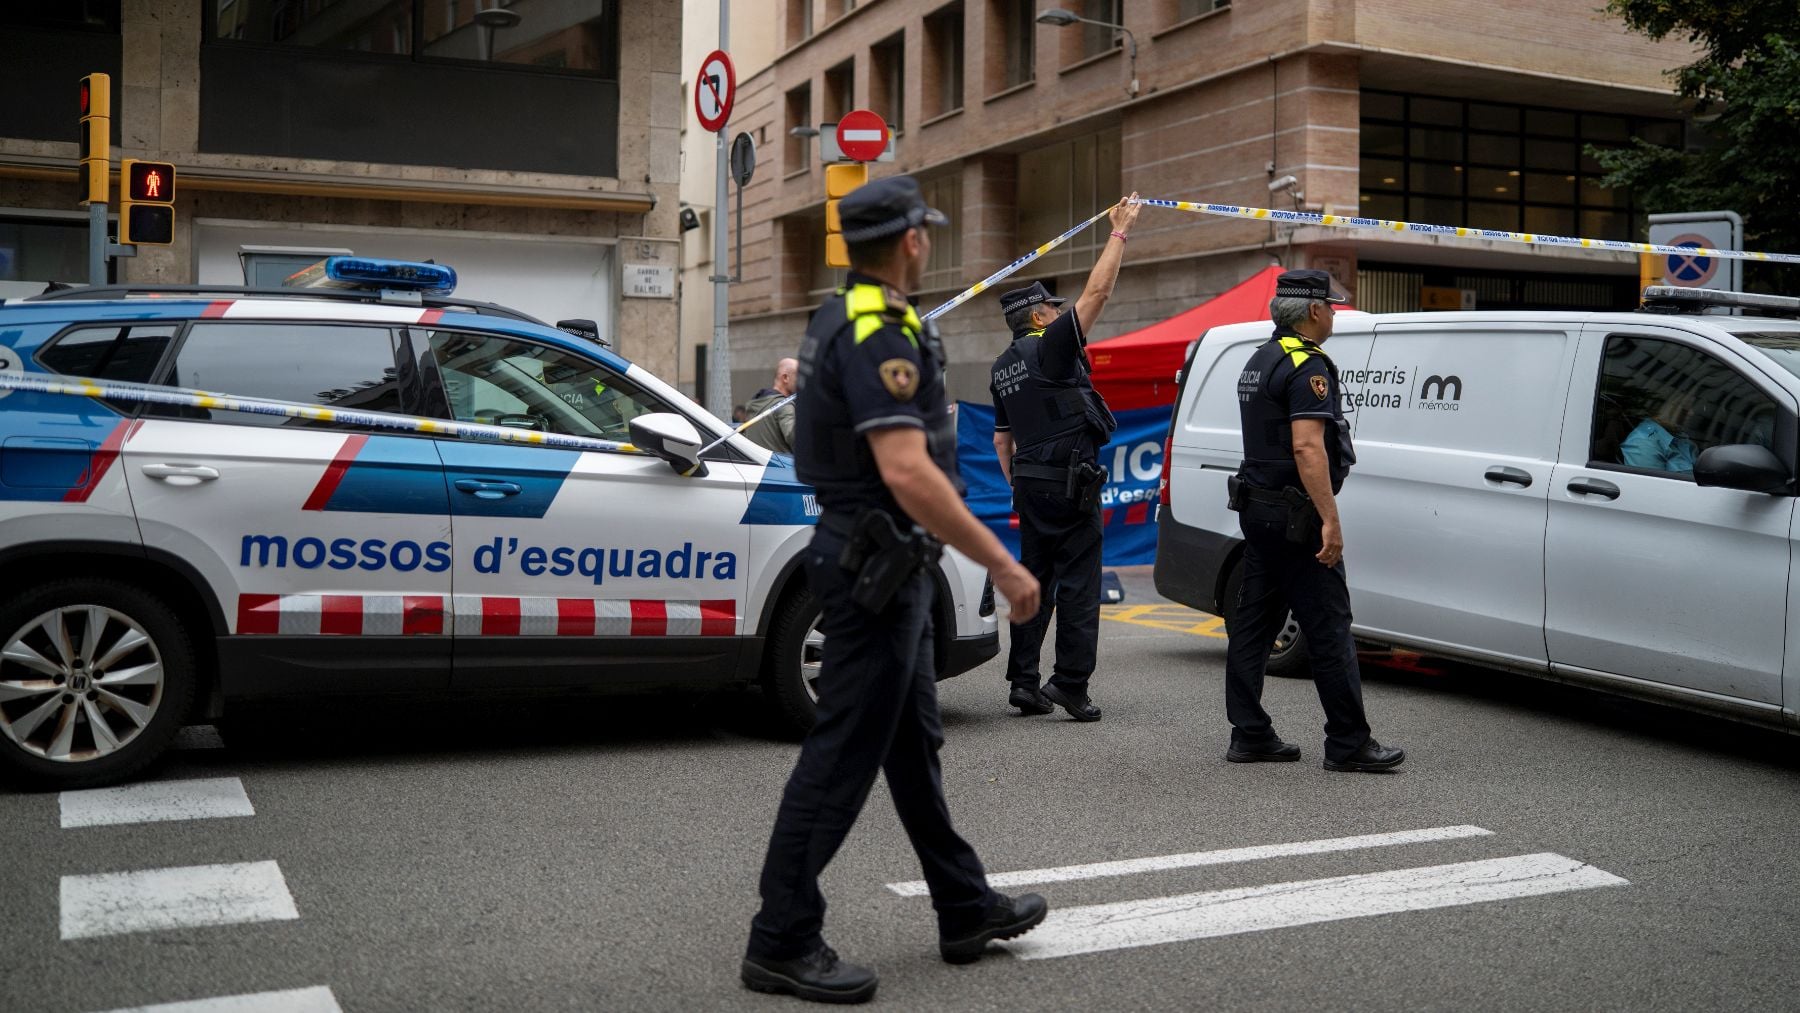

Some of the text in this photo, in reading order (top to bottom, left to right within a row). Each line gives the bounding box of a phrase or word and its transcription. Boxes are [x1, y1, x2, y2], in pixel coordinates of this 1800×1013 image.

[1271, 210, 1296, 220] POLICIA
[995, 360, 1027, 385] POLICIA
[240, 534, 737, 585] mossos d'esquadra
